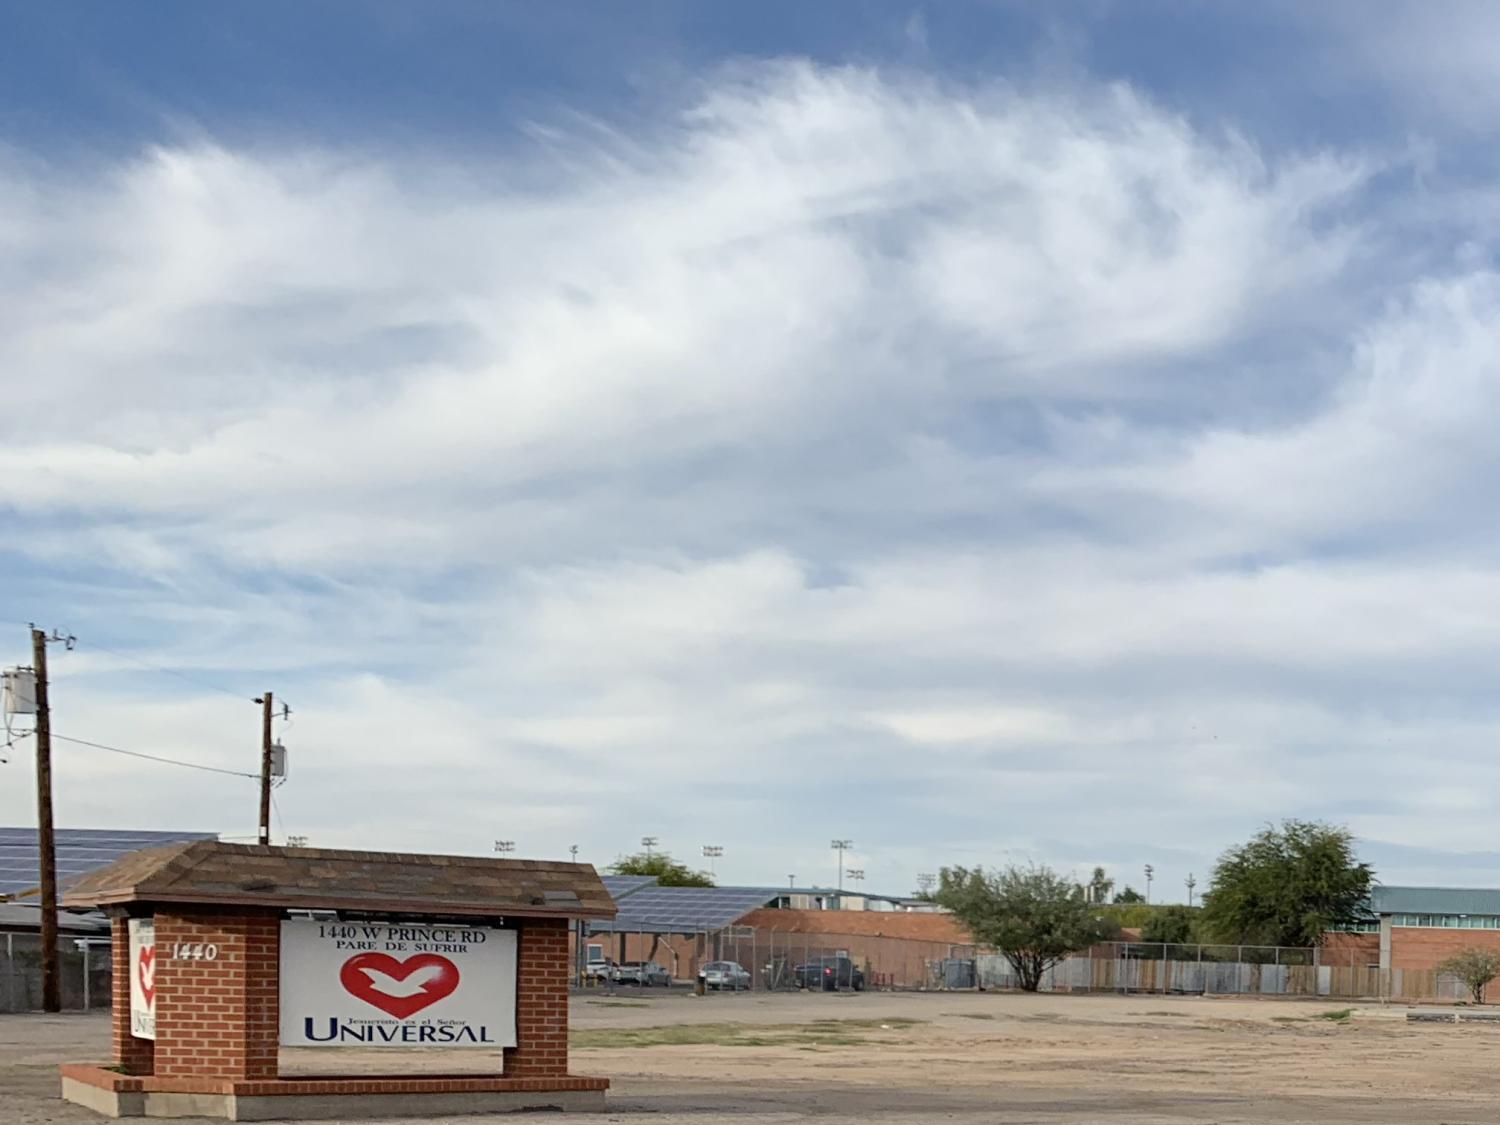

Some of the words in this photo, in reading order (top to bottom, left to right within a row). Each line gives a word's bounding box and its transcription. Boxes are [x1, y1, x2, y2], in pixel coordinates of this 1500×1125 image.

[318, 926, 357, 939] 1440
[362, 928, 382, 940] W
[387, 928, 456, 942] PRINCE
[461, 931, 486, 944] RD
[173, 942, 218, 961] 1440
[336, 940, 377, 950] PARE
[385, 942, 407, 951] DE
[414, 943, 468, 953] SUFRIR
